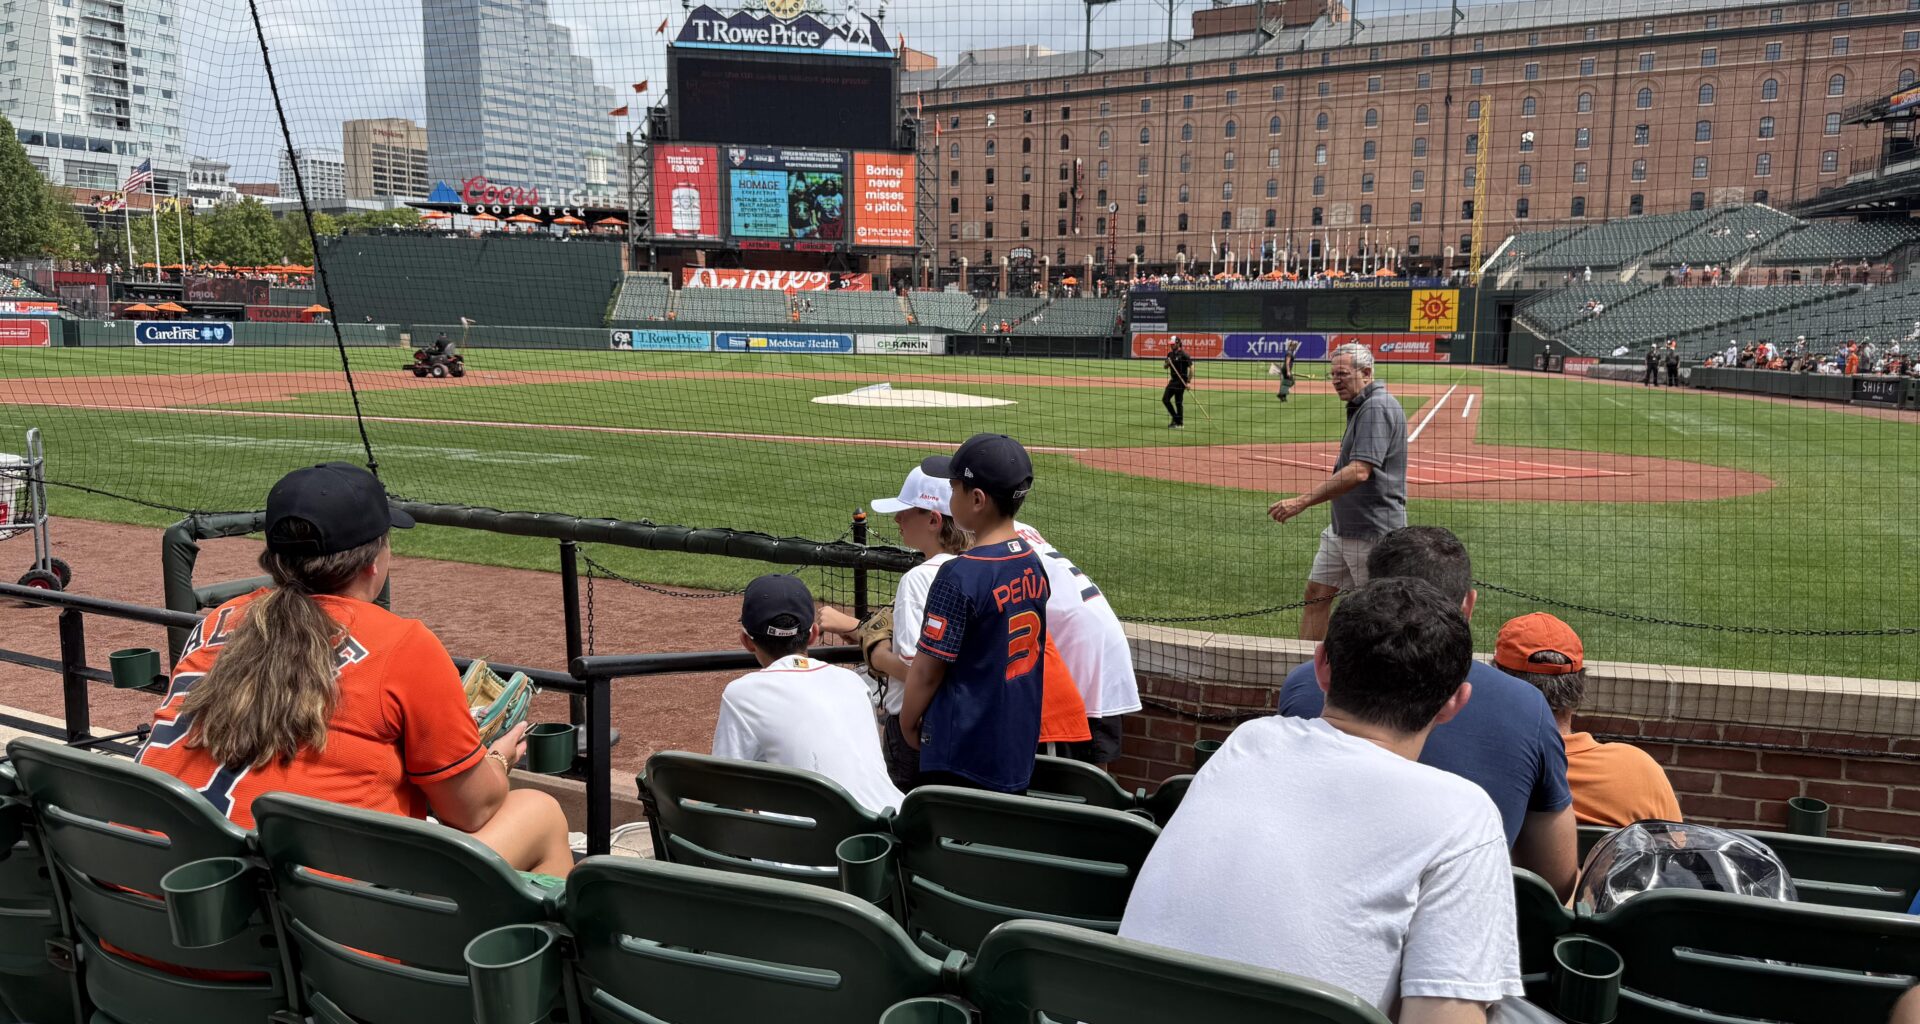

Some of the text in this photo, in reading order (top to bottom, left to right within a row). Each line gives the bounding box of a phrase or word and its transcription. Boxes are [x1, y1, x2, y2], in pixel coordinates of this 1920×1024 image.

[866, 165, 904, 179] Boring
[738, 180, 781, 191] HOMAGE
[869, 179, 901, 189] never
[462, 175, 619, 208] Coors LIGHT
[866, 190, 905, 201] misses
[461, 204, 585, 217] ROOF DECK
[865, 201, 908, 214] a pitch.
[1233, 281, 1280, 291] MARINER
[1282, 279, 1326, 290] FINANCE
[1333, 279, 1377, 289] Personal
[1379, 279, 1409, 288] Loans
[145, 326, 200, 341] CareFirst
[768, 339, 840, 349] MedStar Health
[1862, 381, 1886, 394] SHIFT
[1006, 610, 1042, 681] 3
